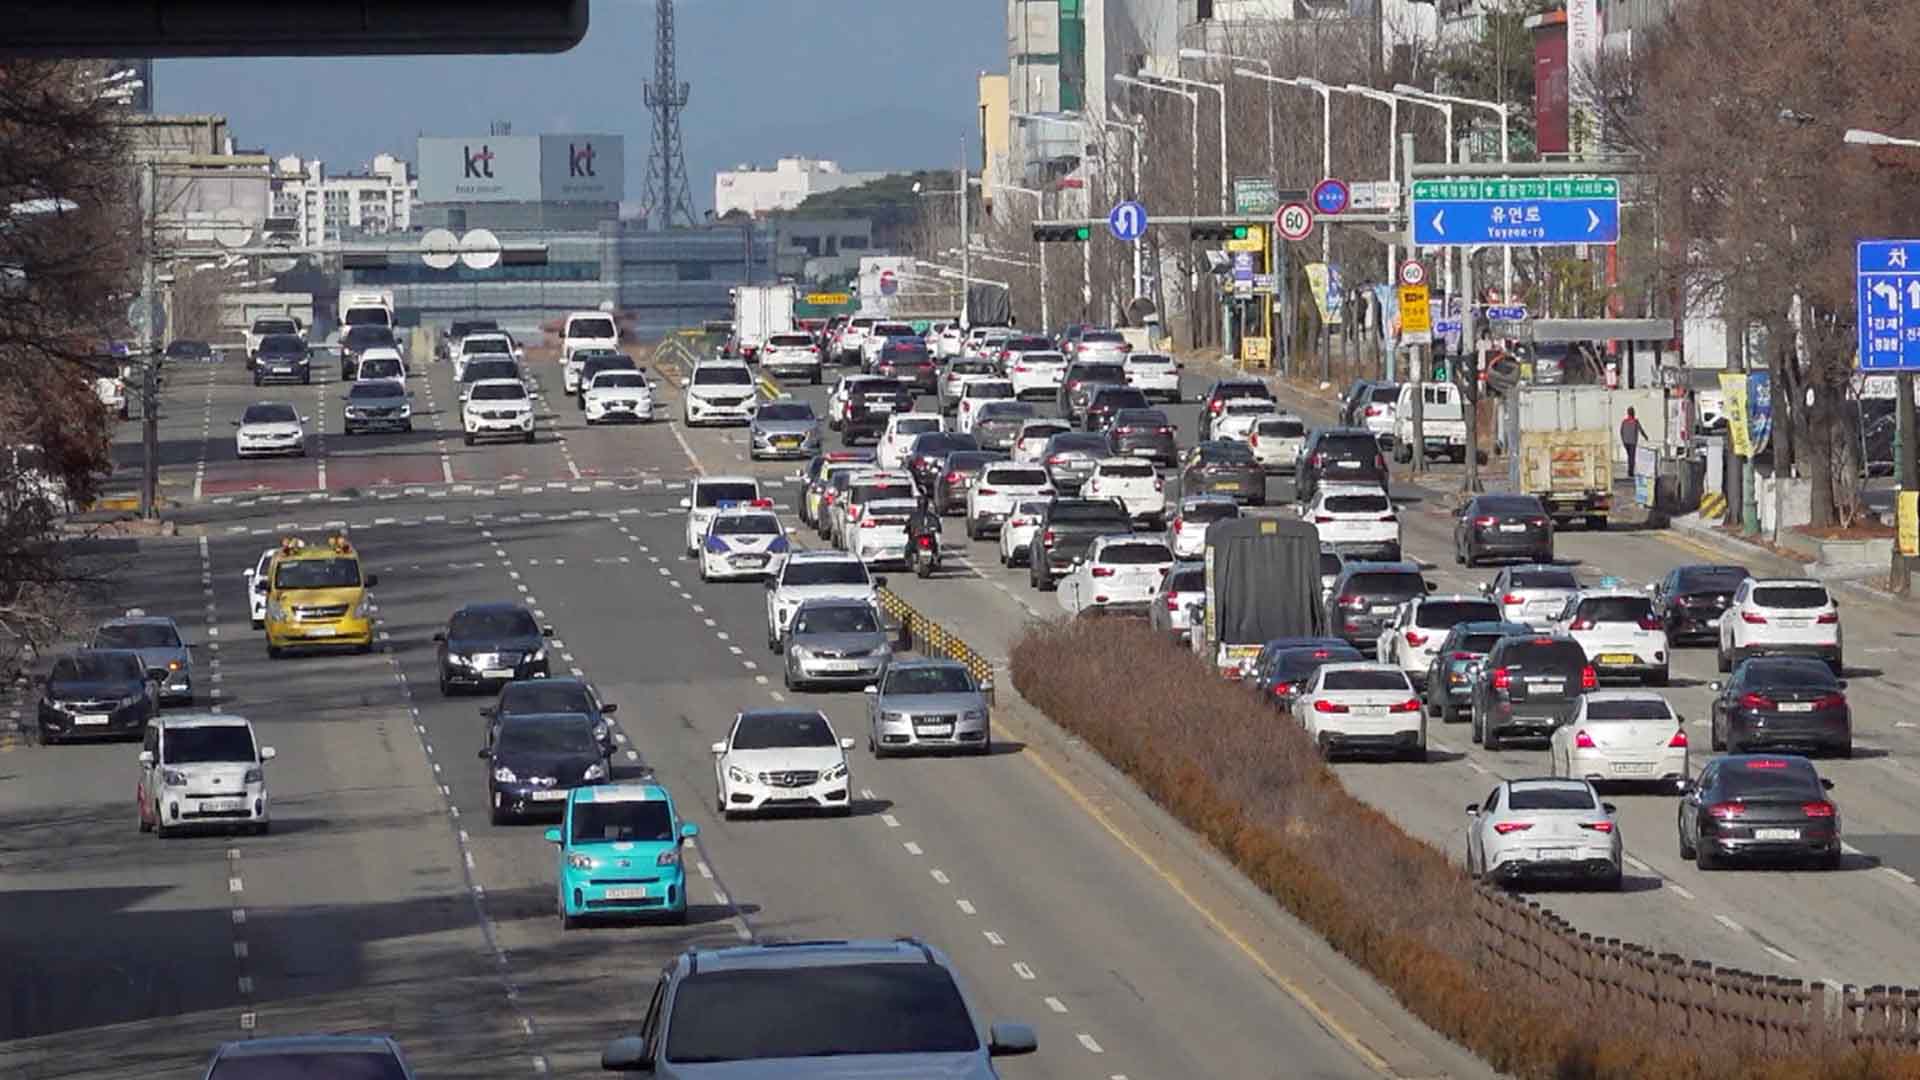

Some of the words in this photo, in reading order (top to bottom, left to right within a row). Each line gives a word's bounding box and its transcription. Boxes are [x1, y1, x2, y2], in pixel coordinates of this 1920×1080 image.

[463, 144, 495, 178] kt
[569, 142, 597, 177] kt
[1285, 212, 1304, 231] 60
[1887, 247, 1909, 269] 차
[1406, 268, 1420, 279] 60
